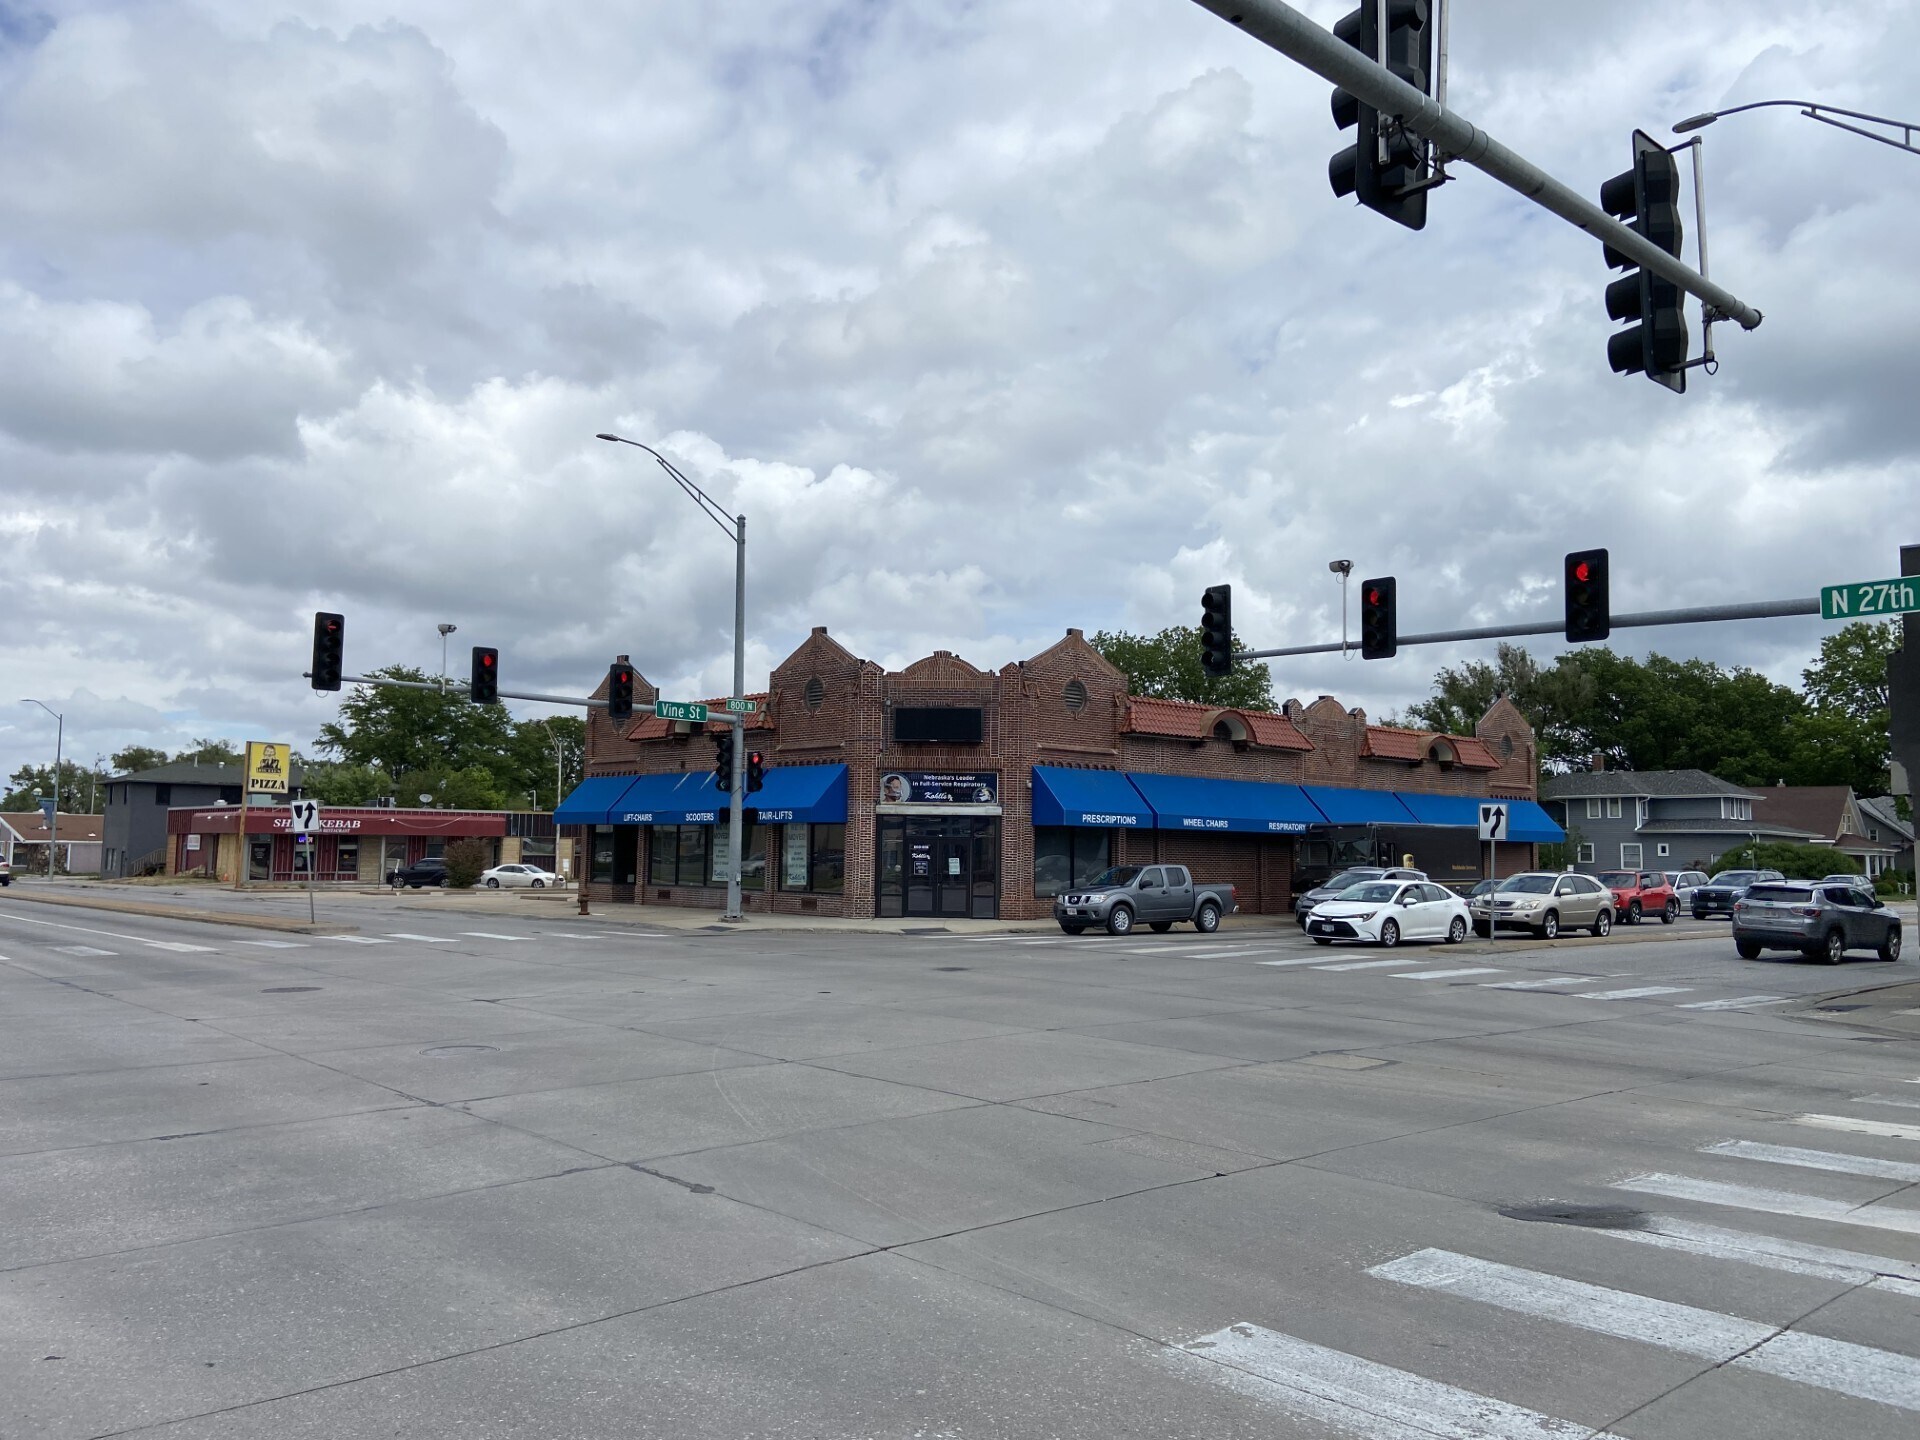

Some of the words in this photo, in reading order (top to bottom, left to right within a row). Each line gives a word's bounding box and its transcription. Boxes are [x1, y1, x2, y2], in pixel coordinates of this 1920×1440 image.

[1832, 588, 1848, 614] N
[1858, 582, 1914, 612] 27th
[662, 703, 684, 718] Vine
[689, 706, 700, 719] St
[730, 702, 744, 710] 800
[251, 779, 285, 789] PIZZA
[686, 813, 714, 821] SCOOTERS
[758, 810, 793, 820] TAIR-LIFTS
[1082, 814, 1136, 824] PRESCRIPTIONS
[319, 819, 361, 828] KEBAB
[1183, 818, 1205, 827] WHEEL
[1206, 819, 1228, 828] CHAIRS
[1268, 822, 1306, 831] RESPIRATORY
